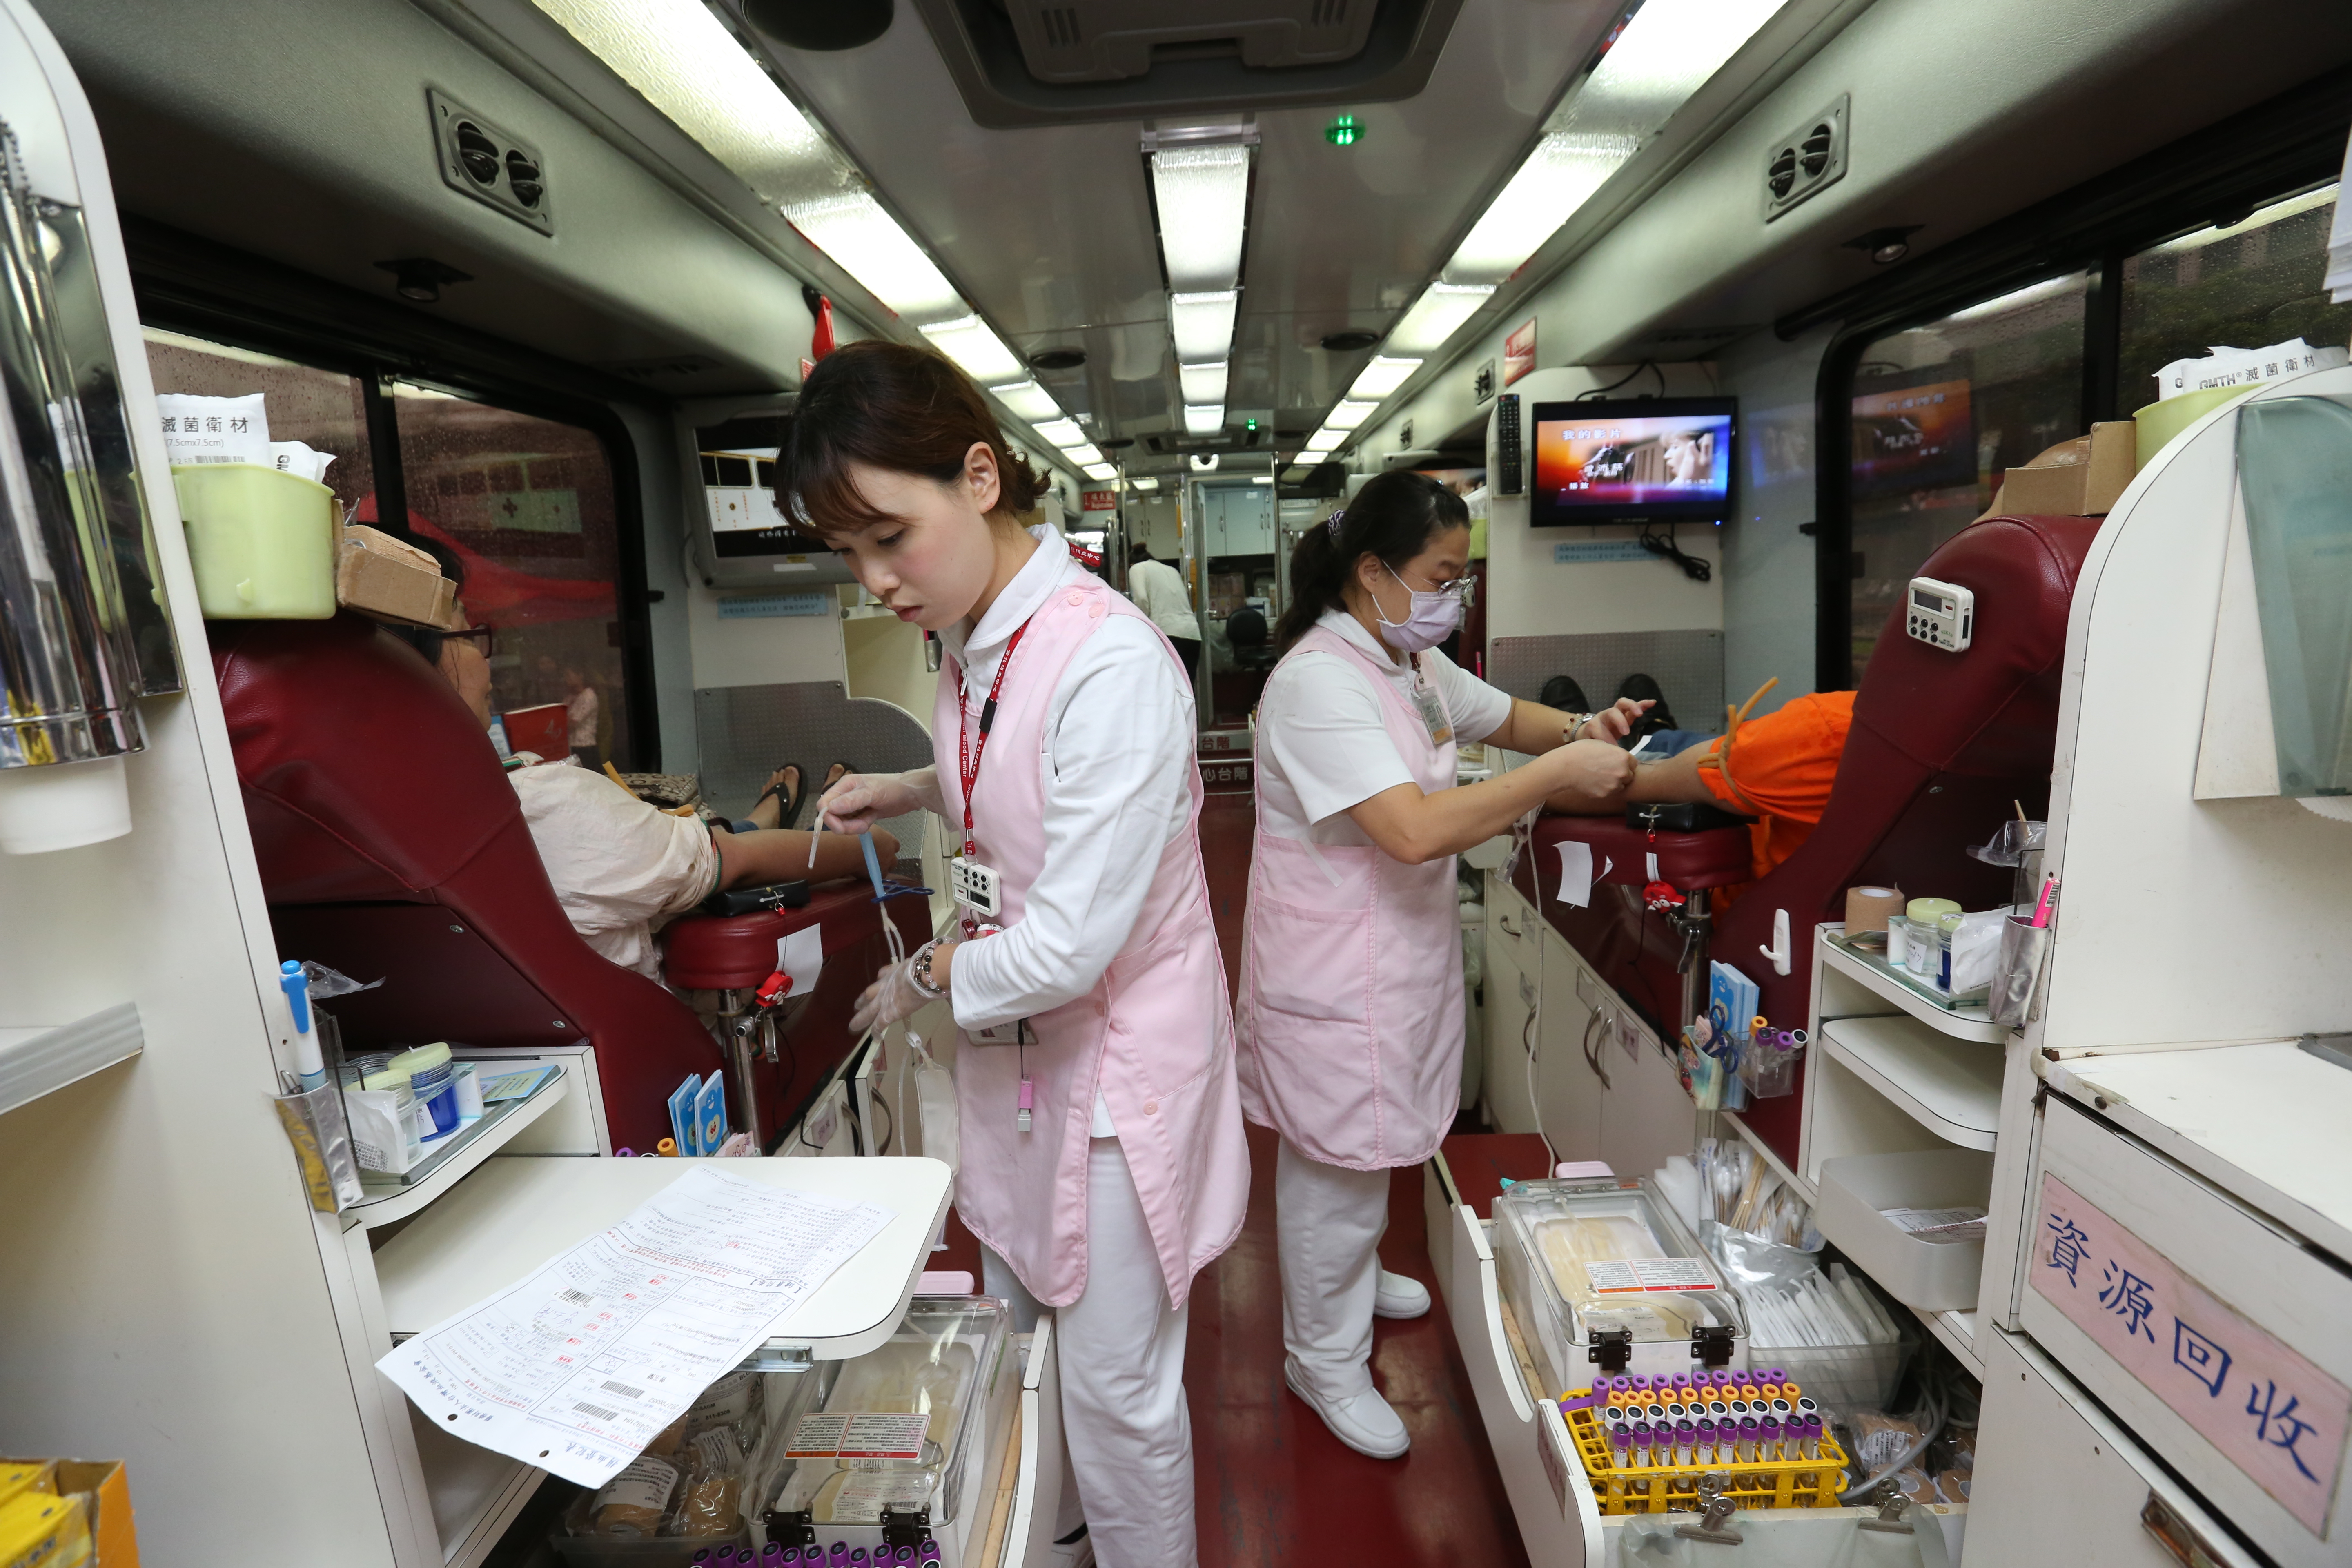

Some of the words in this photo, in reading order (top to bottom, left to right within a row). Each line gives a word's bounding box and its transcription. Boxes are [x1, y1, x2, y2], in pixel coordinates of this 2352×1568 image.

[2245, 354, 2315, 381] 滅菌衛材
[162, 416, 248, 433] 滅菌衛材
[1563, 429, 1622, 440] 我的影片
[1202, 766, 1248, 782] 心台階
[2047, 1213, 2321, 1486] 資源回收
[561, 1441, 621, 1469] 捐血登記表
